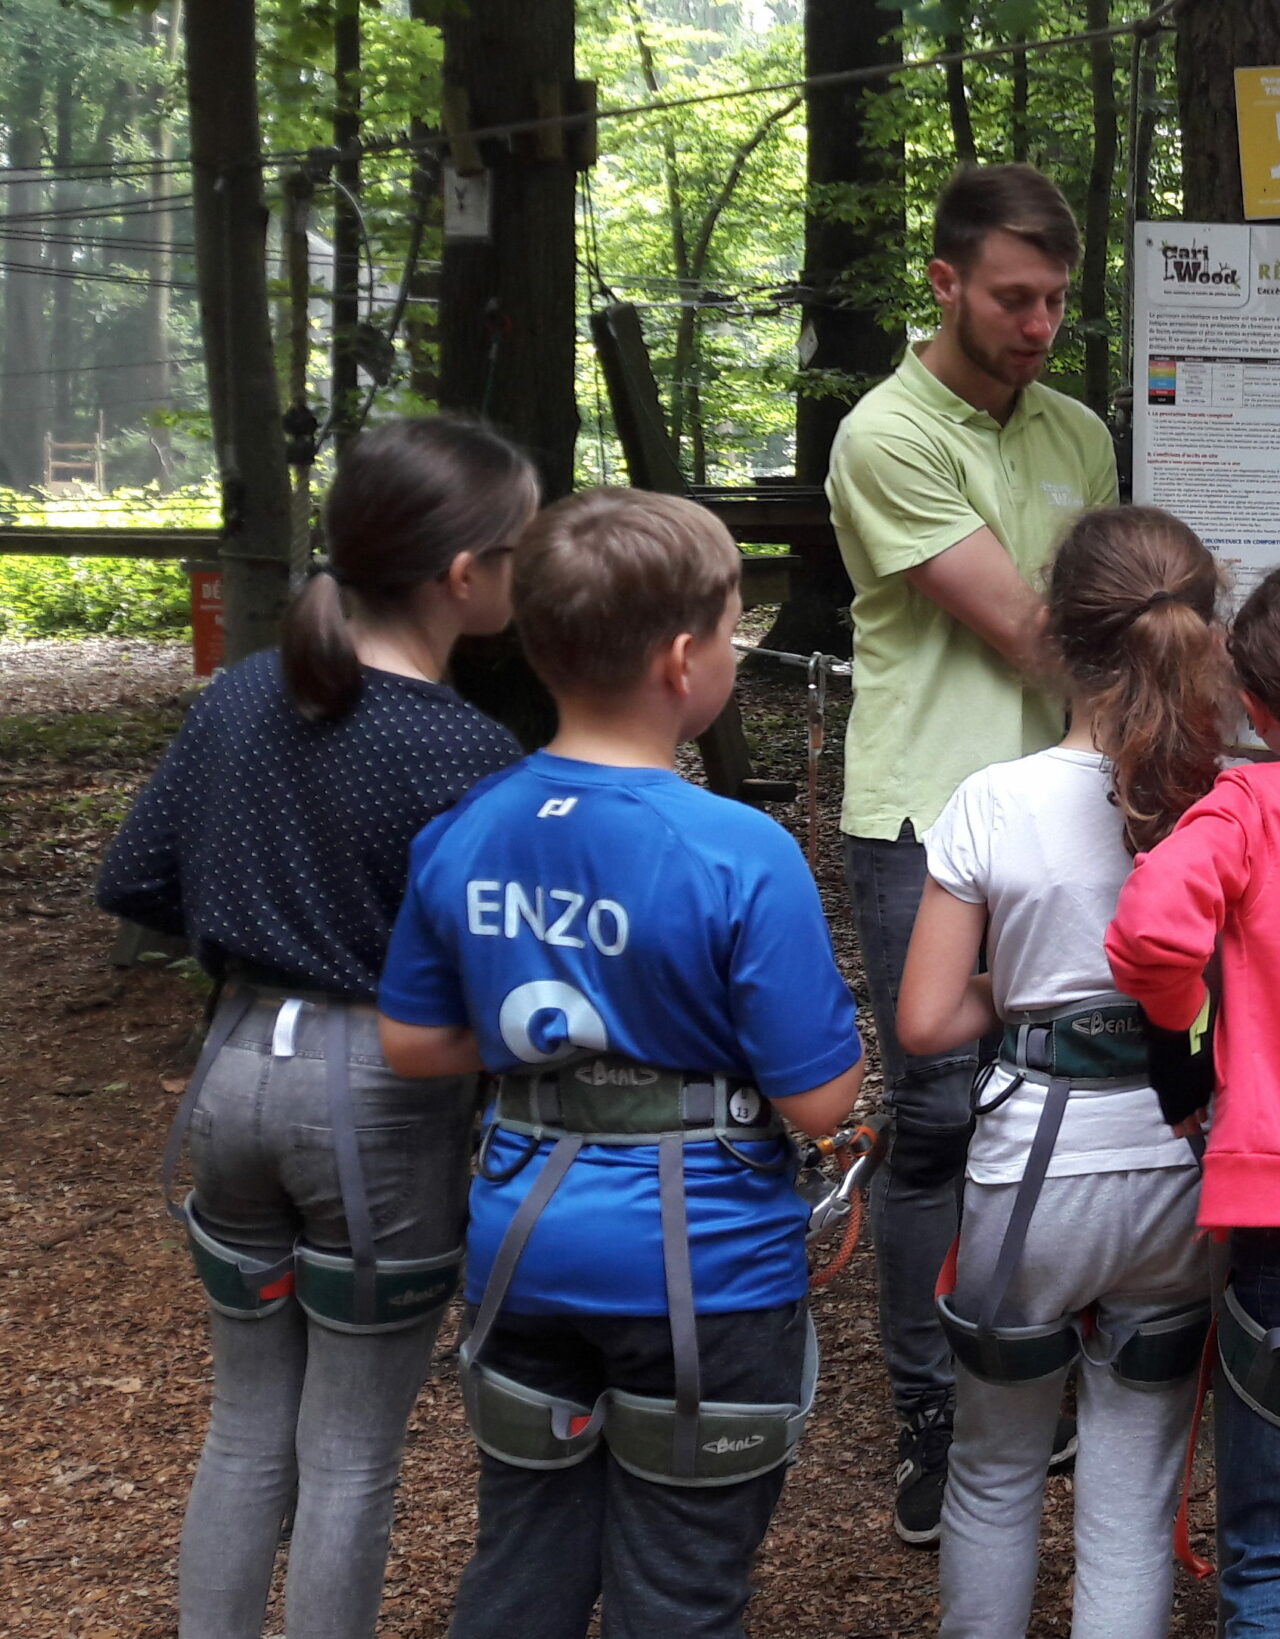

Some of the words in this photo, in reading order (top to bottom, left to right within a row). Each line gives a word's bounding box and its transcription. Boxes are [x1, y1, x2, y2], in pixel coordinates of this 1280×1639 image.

[1174, 261, 1237, 285] Wood
[201, 579, 222, 599] DÉ
[467, 880, 629, 957] ENZO
[735, 1106, 749, 1119] 13
